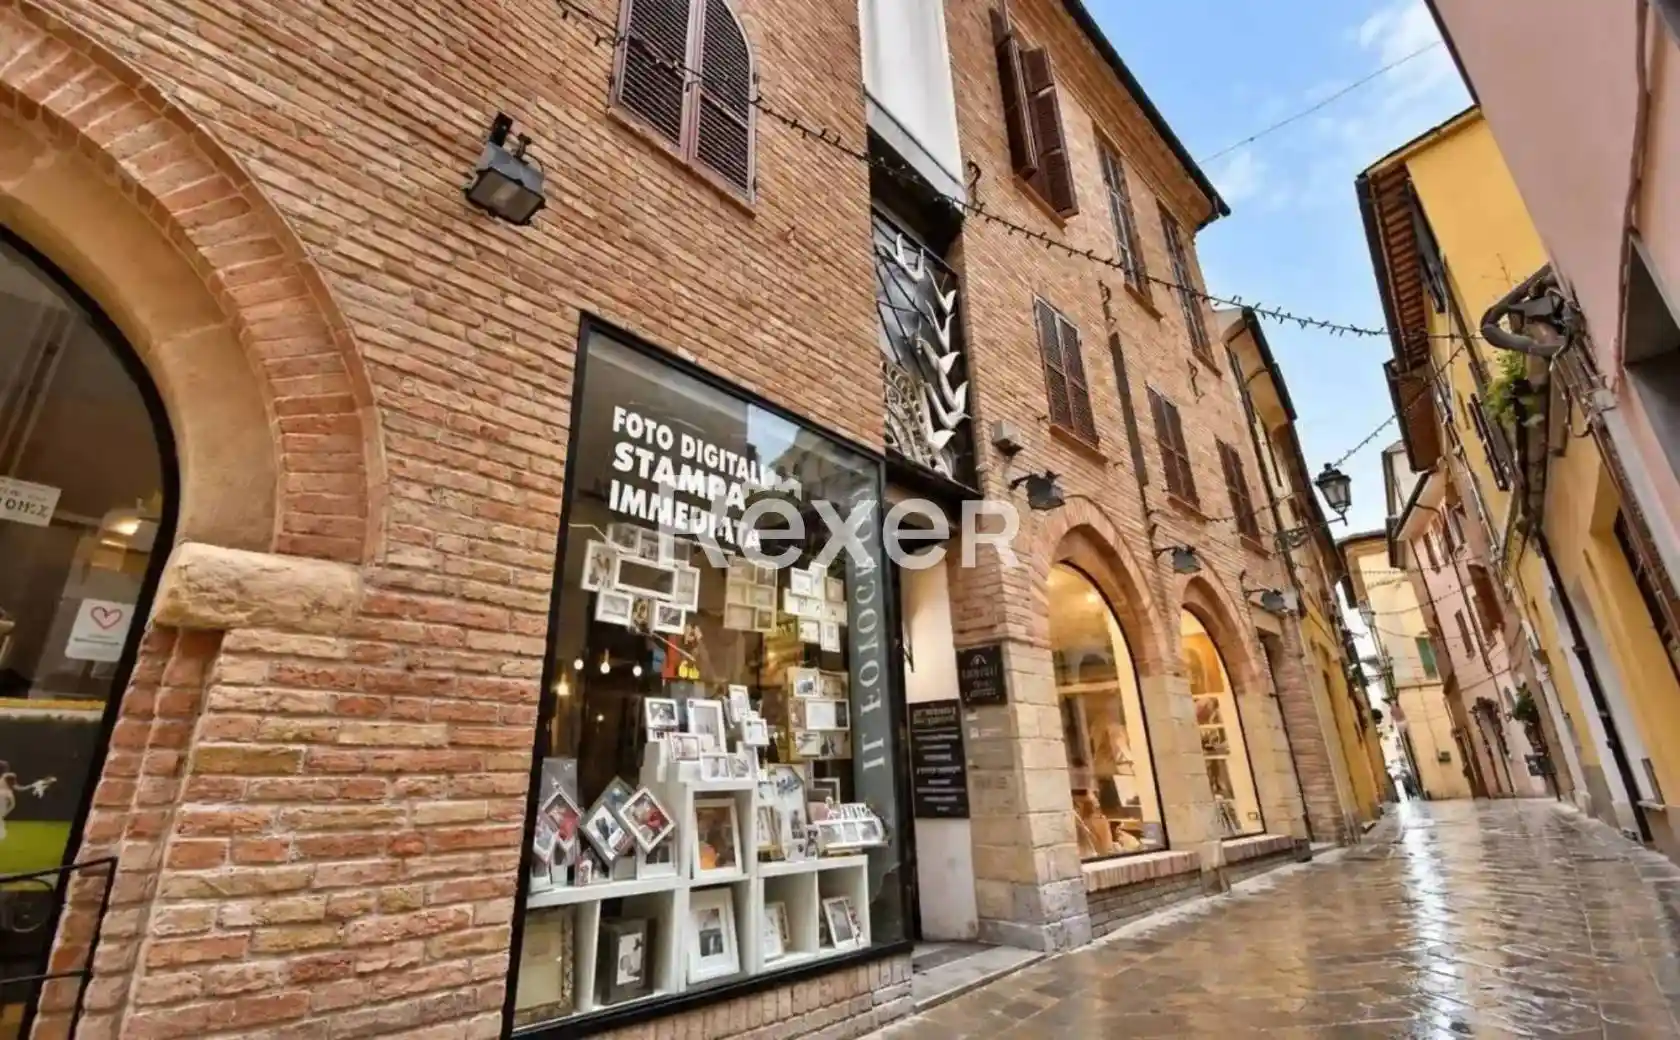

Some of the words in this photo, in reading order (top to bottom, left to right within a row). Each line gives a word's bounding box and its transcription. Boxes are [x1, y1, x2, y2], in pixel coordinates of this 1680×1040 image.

[611, 405, 674, 452] FOTO
[612, 442, 746, 511] STAMPA
[608, 480, 762, 552] IMMEDIATA
